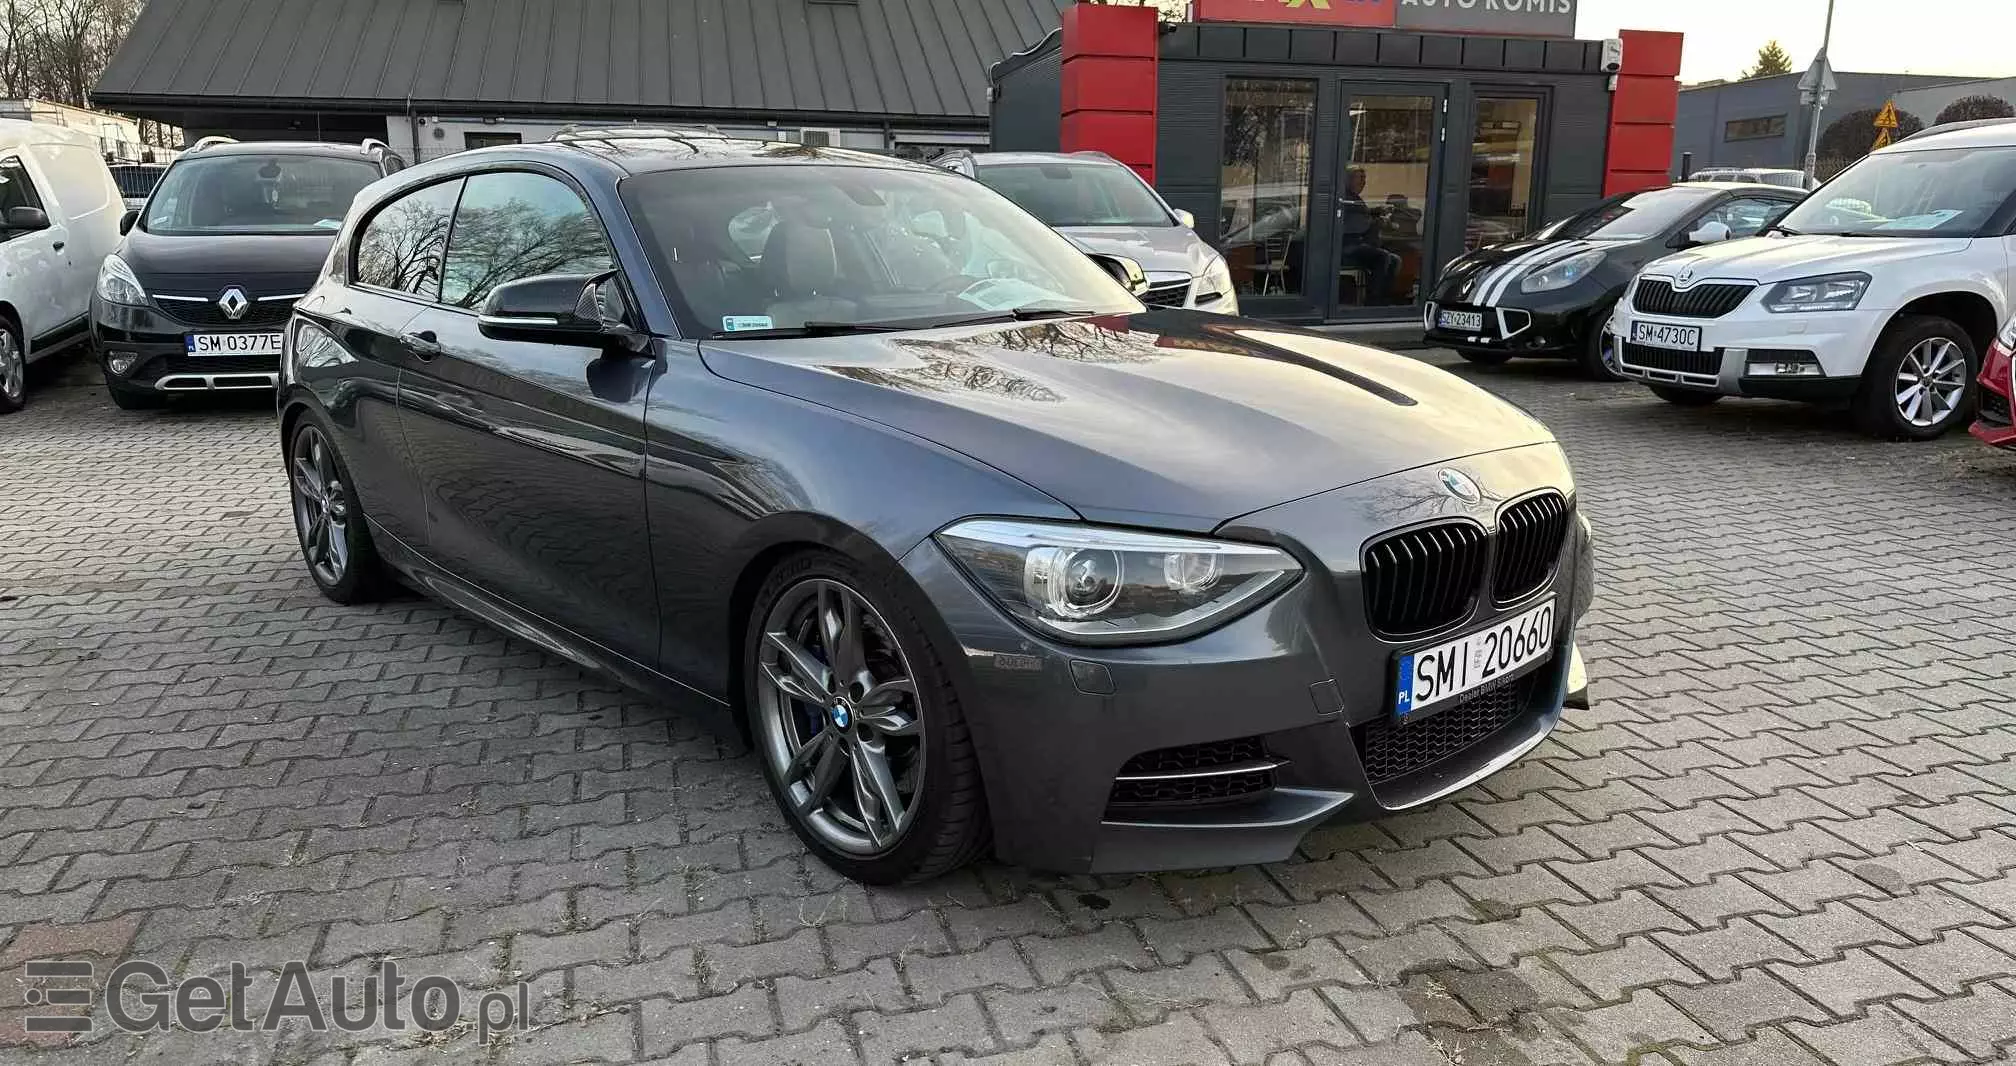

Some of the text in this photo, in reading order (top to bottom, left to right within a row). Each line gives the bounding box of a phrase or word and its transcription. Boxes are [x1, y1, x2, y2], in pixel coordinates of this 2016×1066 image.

[1456, 313, 1481, 327] 23413
[198, 335, 281, 352] SM 0377E
[1639, 325, 1654, 341] SM
[1657, 326, 1696, 346] 4730C
[1398, 606, 1551, 704] PL SMI 20660
